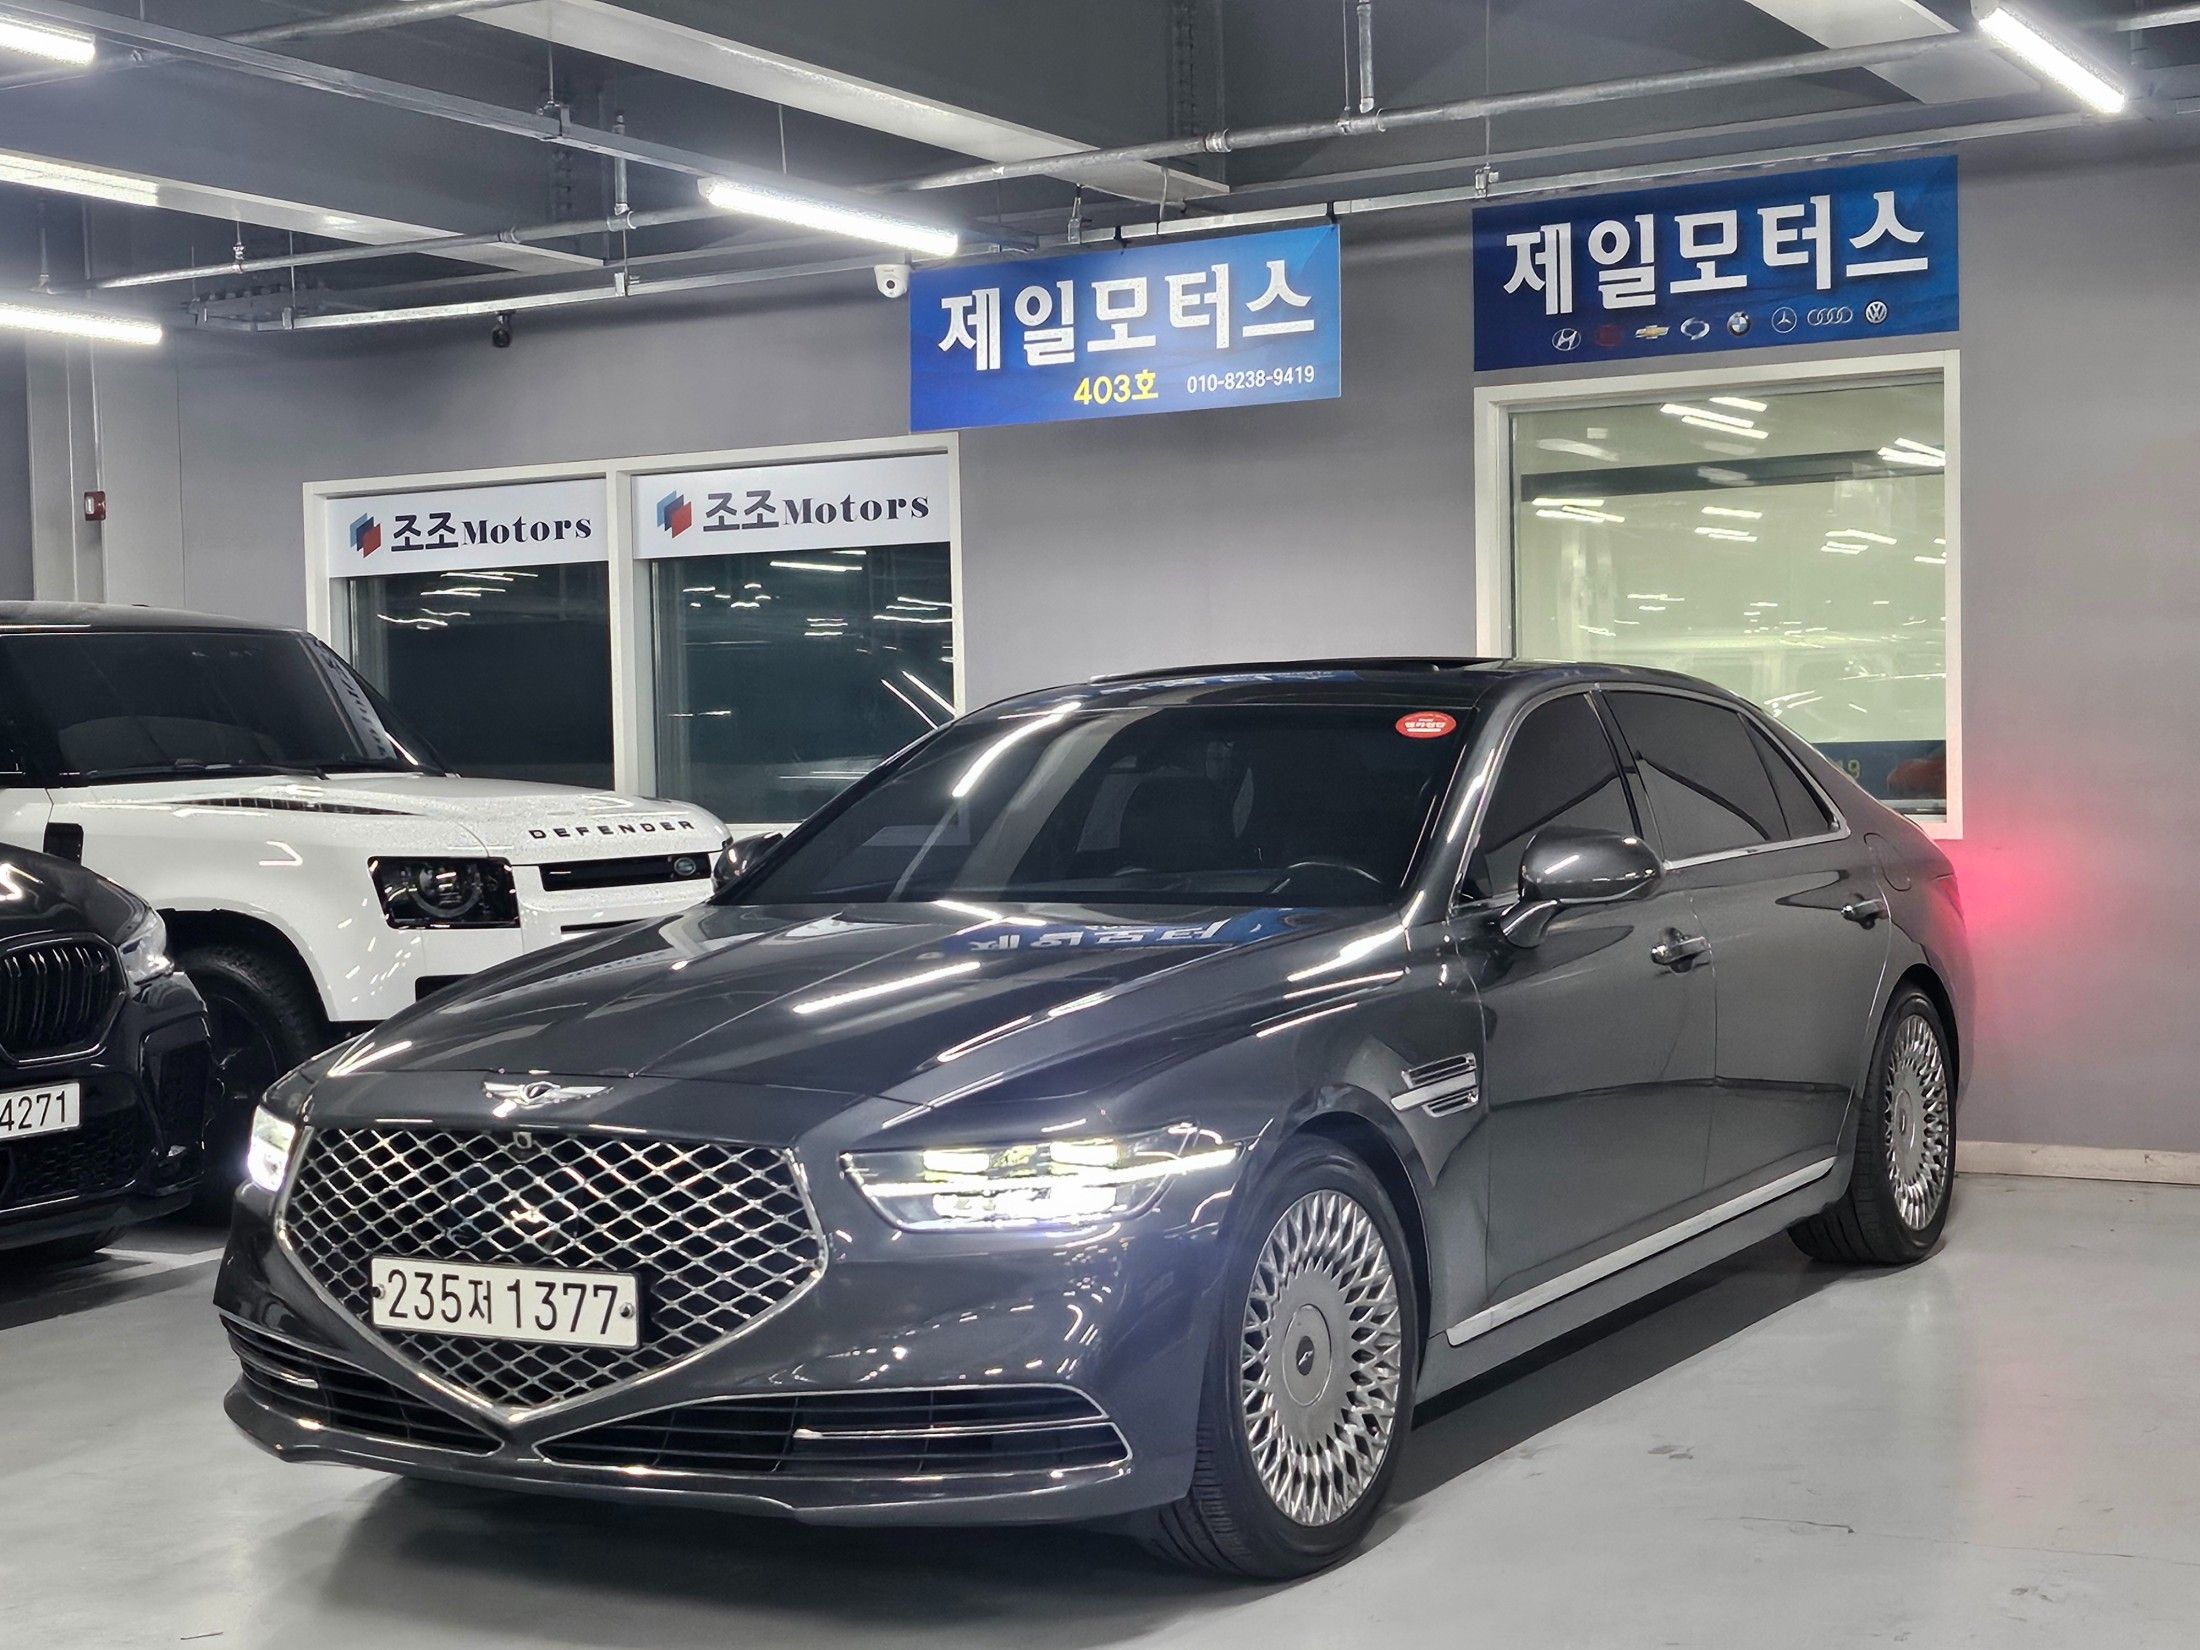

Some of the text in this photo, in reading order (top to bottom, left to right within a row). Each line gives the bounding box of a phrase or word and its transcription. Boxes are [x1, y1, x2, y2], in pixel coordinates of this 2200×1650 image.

[1502, 190, 1929, 315] 제일모터스
[938, 259, 1315, 371] 제일모터스
[1074, 364, 1315, 405] 403호 010-8238-9419
[529, 820, 694, 839] DEFENDER
[0, 1090, 66, 1131] 4271
[387, 1268, 619, 1335] 235저 1377
